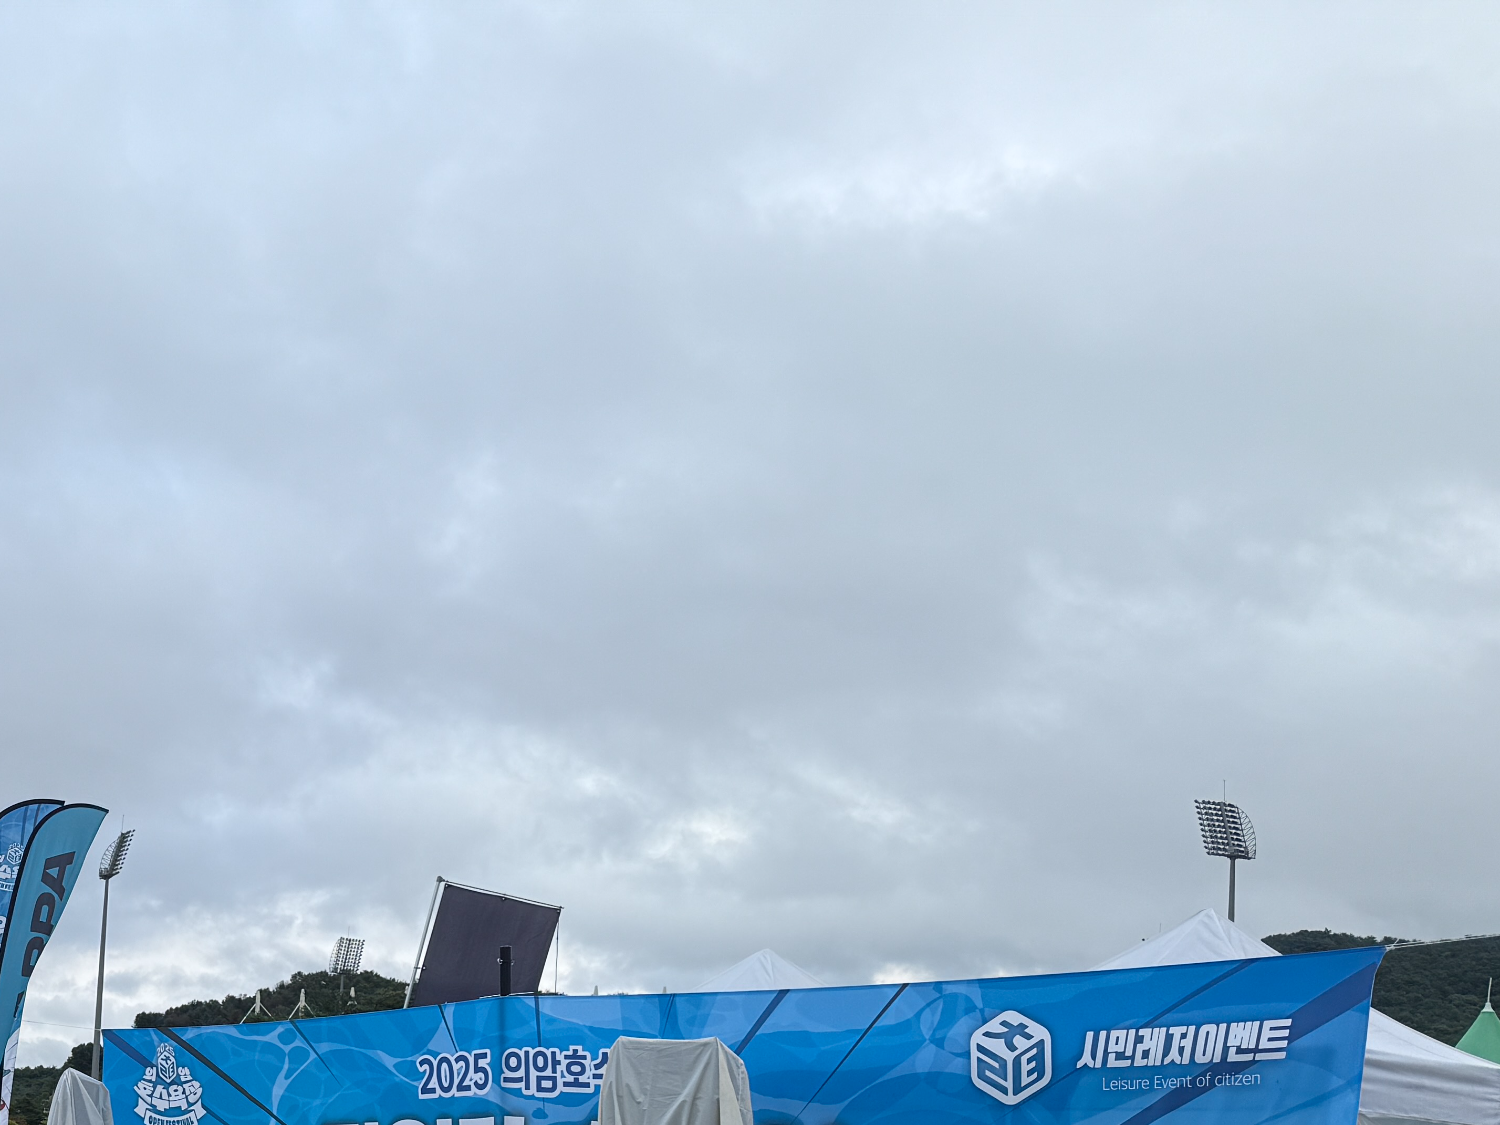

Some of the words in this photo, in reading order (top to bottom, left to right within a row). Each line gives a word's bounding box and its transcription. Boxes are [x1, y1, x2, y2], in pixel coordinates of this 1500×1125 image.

[1076, 1018, 1293, 1070] 시민레저이벤트
[418, 1050, 490, 1098] 2025
[1102, 1075, 1150, 1092] Leisure
[1154, 1074, 1193, 1089] Event
[1196, 1073, 1212, 1088] of
[1213, 1072, 1261, 1087] citizen
[133, 1080, 203, 1112] 호수욕장
